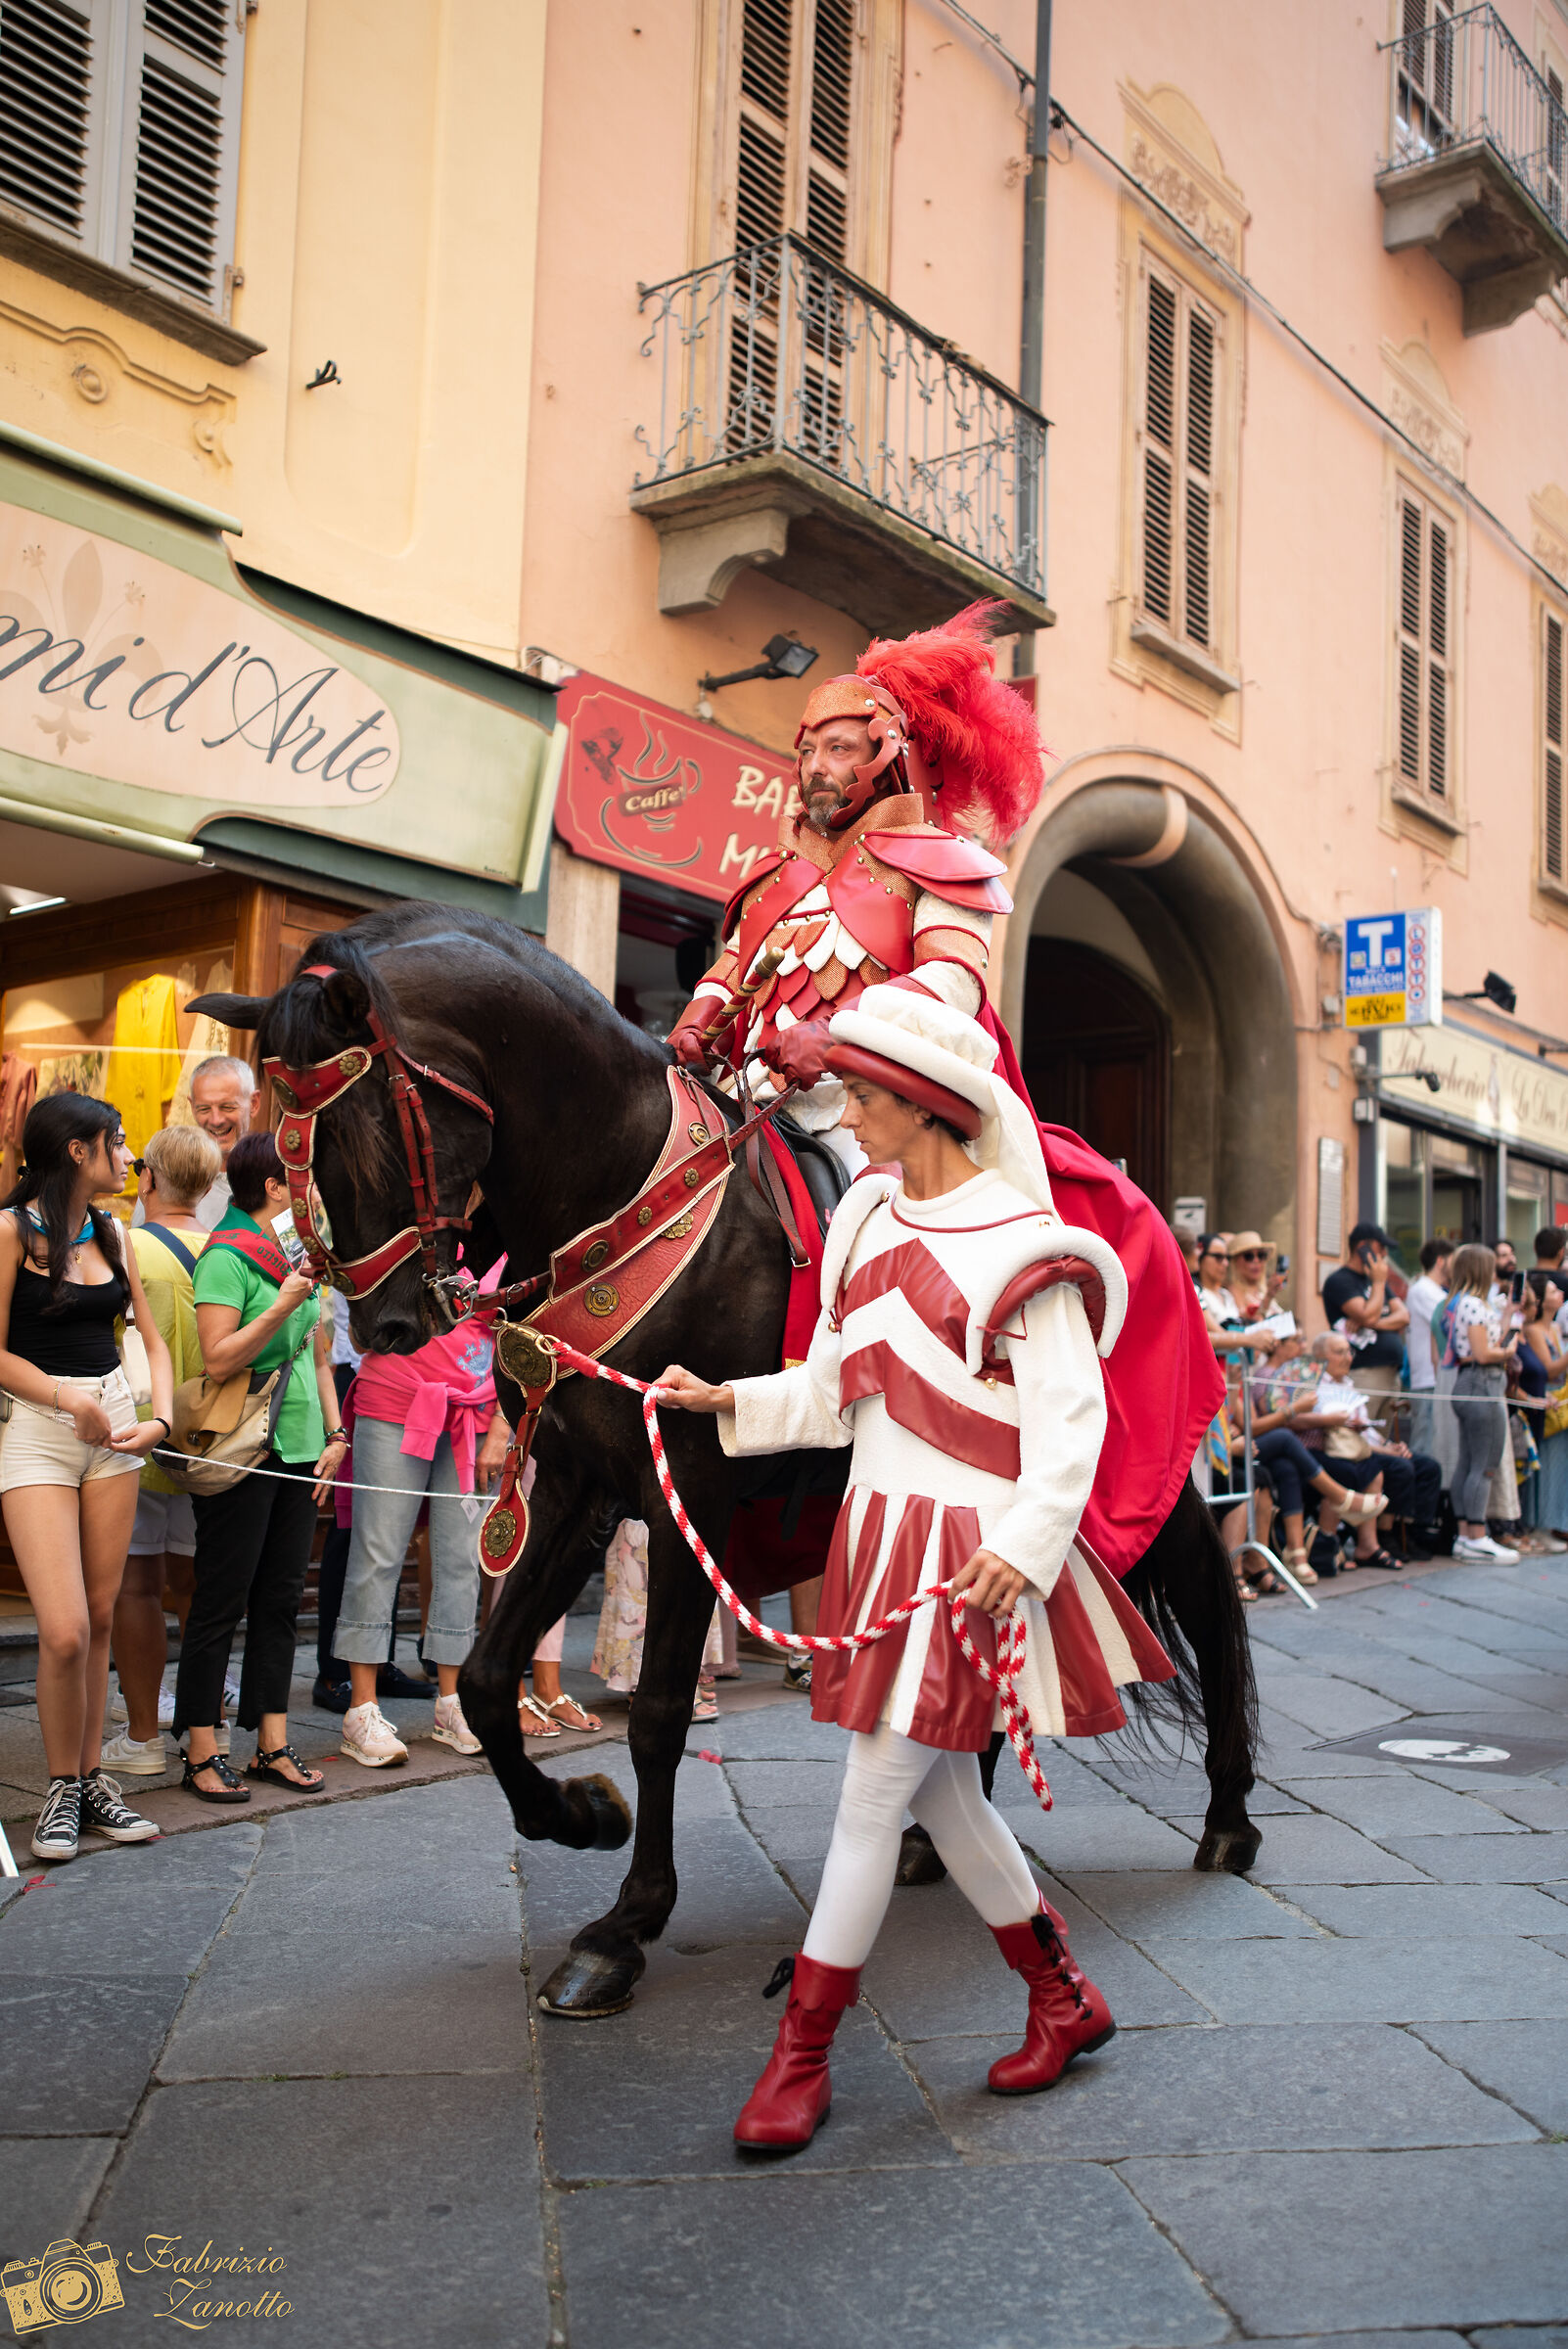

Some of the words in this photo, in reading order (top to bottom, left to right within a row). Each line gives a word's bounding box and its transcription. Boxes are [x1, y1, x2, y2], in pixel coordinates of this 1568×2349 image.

[128, 641, 392, 794] d'Arte
[718, 832, 771, 880] M
[1357, 920, 1395, 967] T
